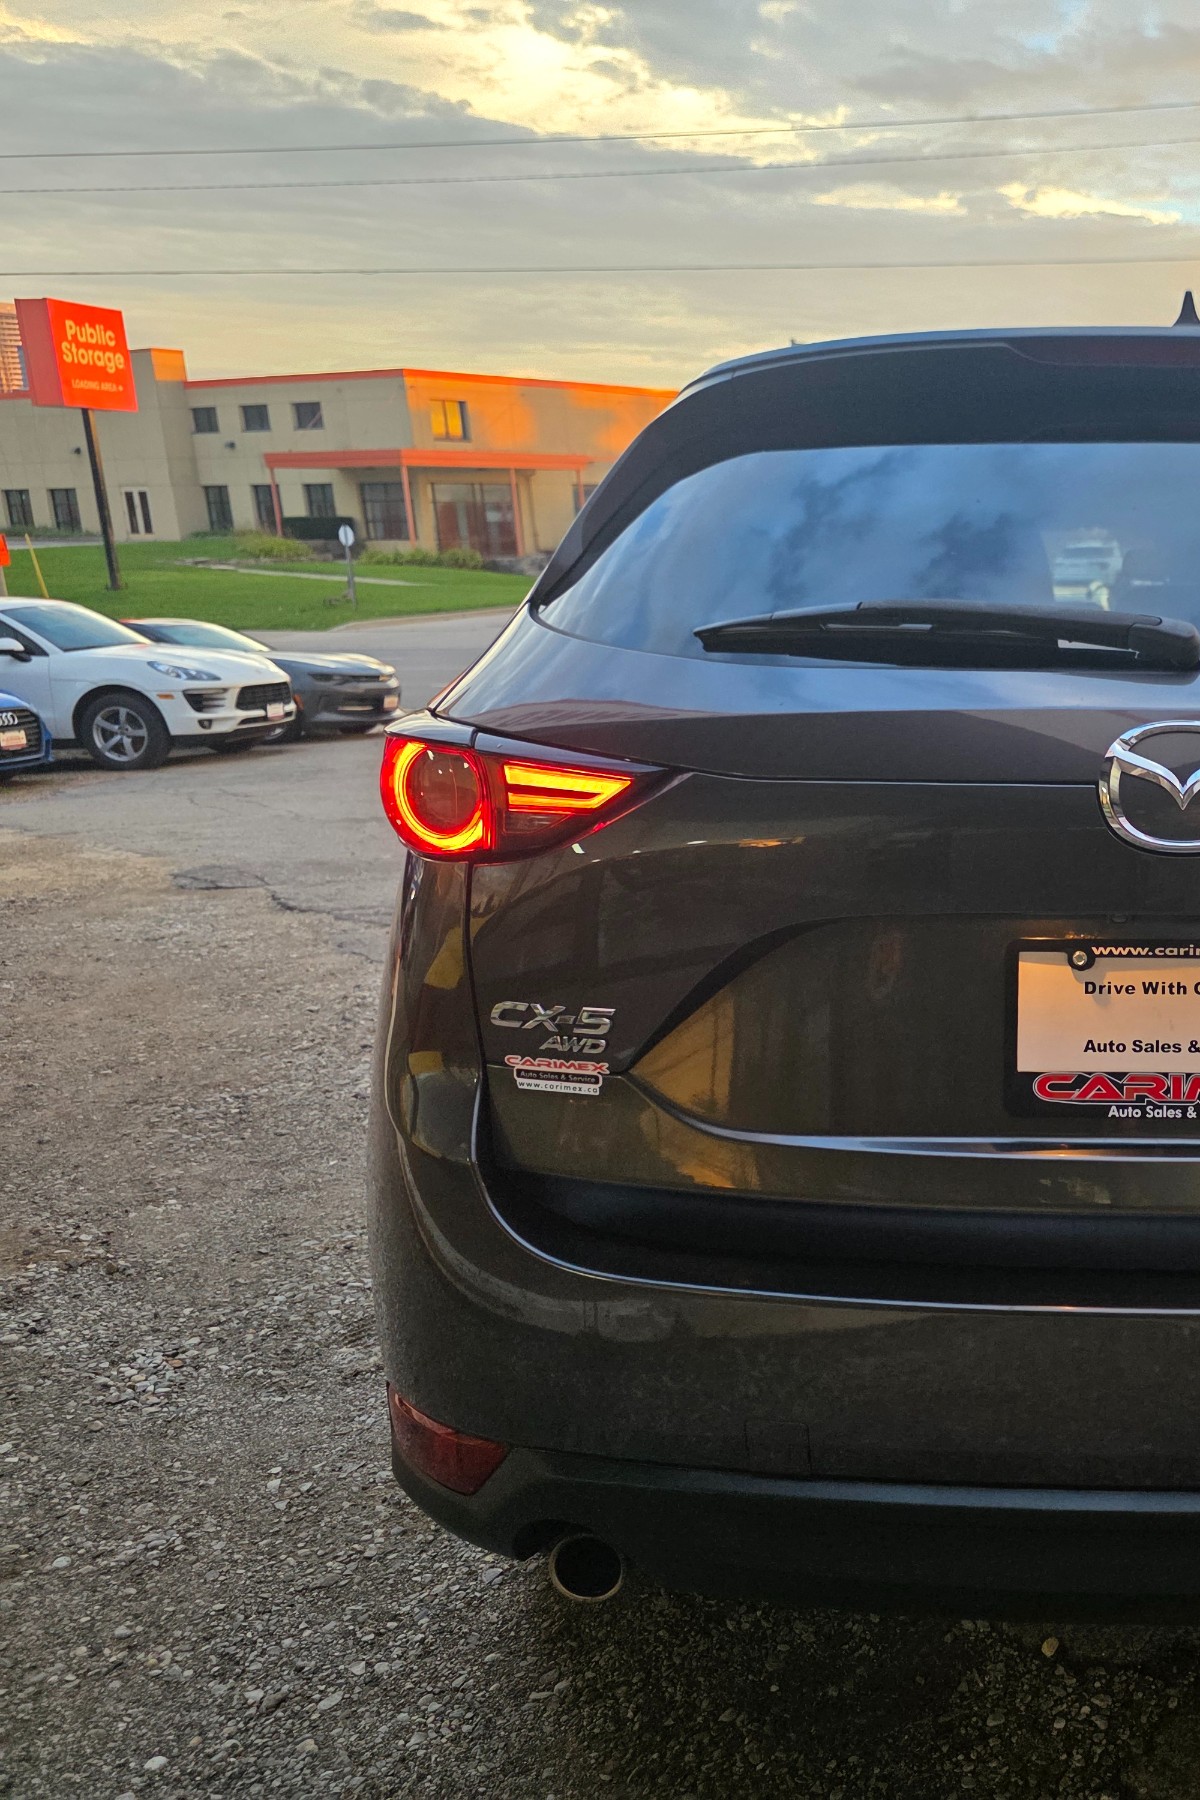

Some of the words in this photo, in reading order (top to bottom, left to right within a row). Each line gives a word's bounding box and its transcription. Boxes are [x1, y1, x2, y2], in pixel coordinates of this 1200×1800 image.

[65, 319, 116, 347] Public
[61, 341, 125, 374] Storage
[1084, 981, 1136, 996] Drive
[1142, 981, 1188, 996] With
[490, 1001, 616, 1035] CX-5
[538, 1035, 607, 1054] AWD
[1083, 1039, 1127, 1053] Auto
[1131, 1039, 1182, 1054] Sales
[505, 1056, 609, 1073] CARIMEX
[520, 1071, 537, 1079] Auto
[568, 1074, 596, 1083] Service
[518, 1080, 599, 1094] www.carimex.ca
[1108, 1105, 1142, 1119] Auto
[1146, 1106, 1183, 1119] Sales
[1187, 1107, 1198, 1119] &
